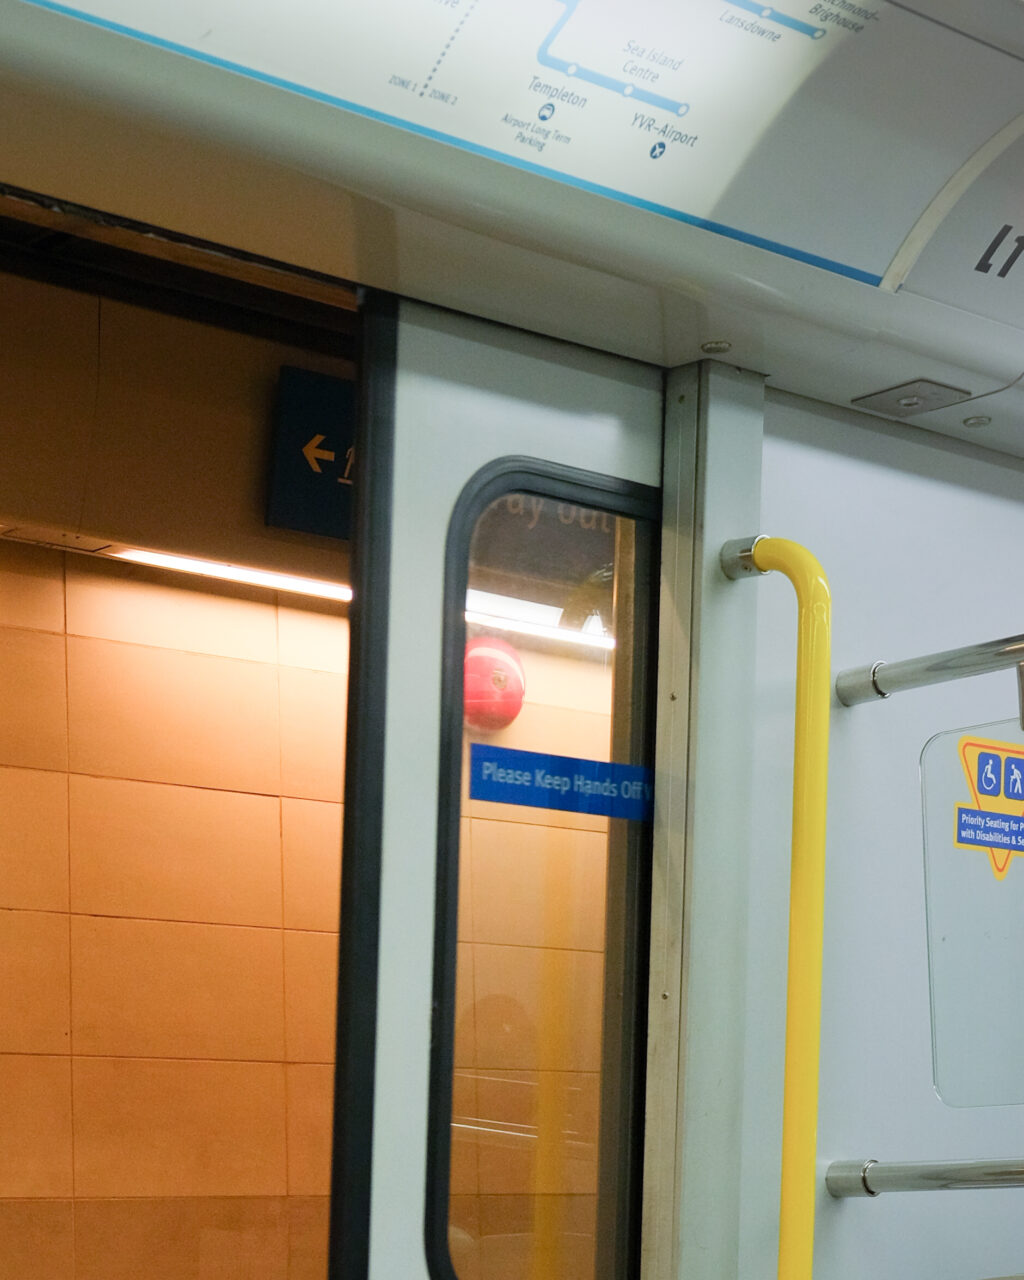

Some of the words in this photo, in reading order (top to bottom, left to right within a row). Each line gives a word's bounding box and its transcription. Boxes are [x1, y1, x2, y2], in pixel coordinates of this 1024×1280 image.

[719, 9, 782, 42] Lansdowne
[808, 3, 865, 33] Brighouse
[622, 39, 646, 58] Sea
[646, 48, 686, 71] Island
[387, 74, 412, 91] ZONE
[622, 60, 660, 82] Centre
[428, 88, 451, 103] ZONE
[450, 95, 458, 106] 2
[527, 75, 588, 109] Templeton
[501, 112, 531, 132] Airport
[529, 119, 550, 140] Long
[551, 129, 572, 145] Term
[514, 131, 546, 152] Parking
[631, 112, 698, 148] YVR-Airport
[482, 761, 532, 787] Please
[534, 768, 571, 795] Keep
[573, 773, 618, 798] Hands
[620, 780, 643, 800] Off
[960, 828, 975, 839] with
[976, 830, 1010, 844] Disabilities
[1011, 836, 1017, 845] &
[961, 813, 985, 829] Priority
[985, 817, 1010, 832] Seating
[1010, 820, 1019, 831] for
